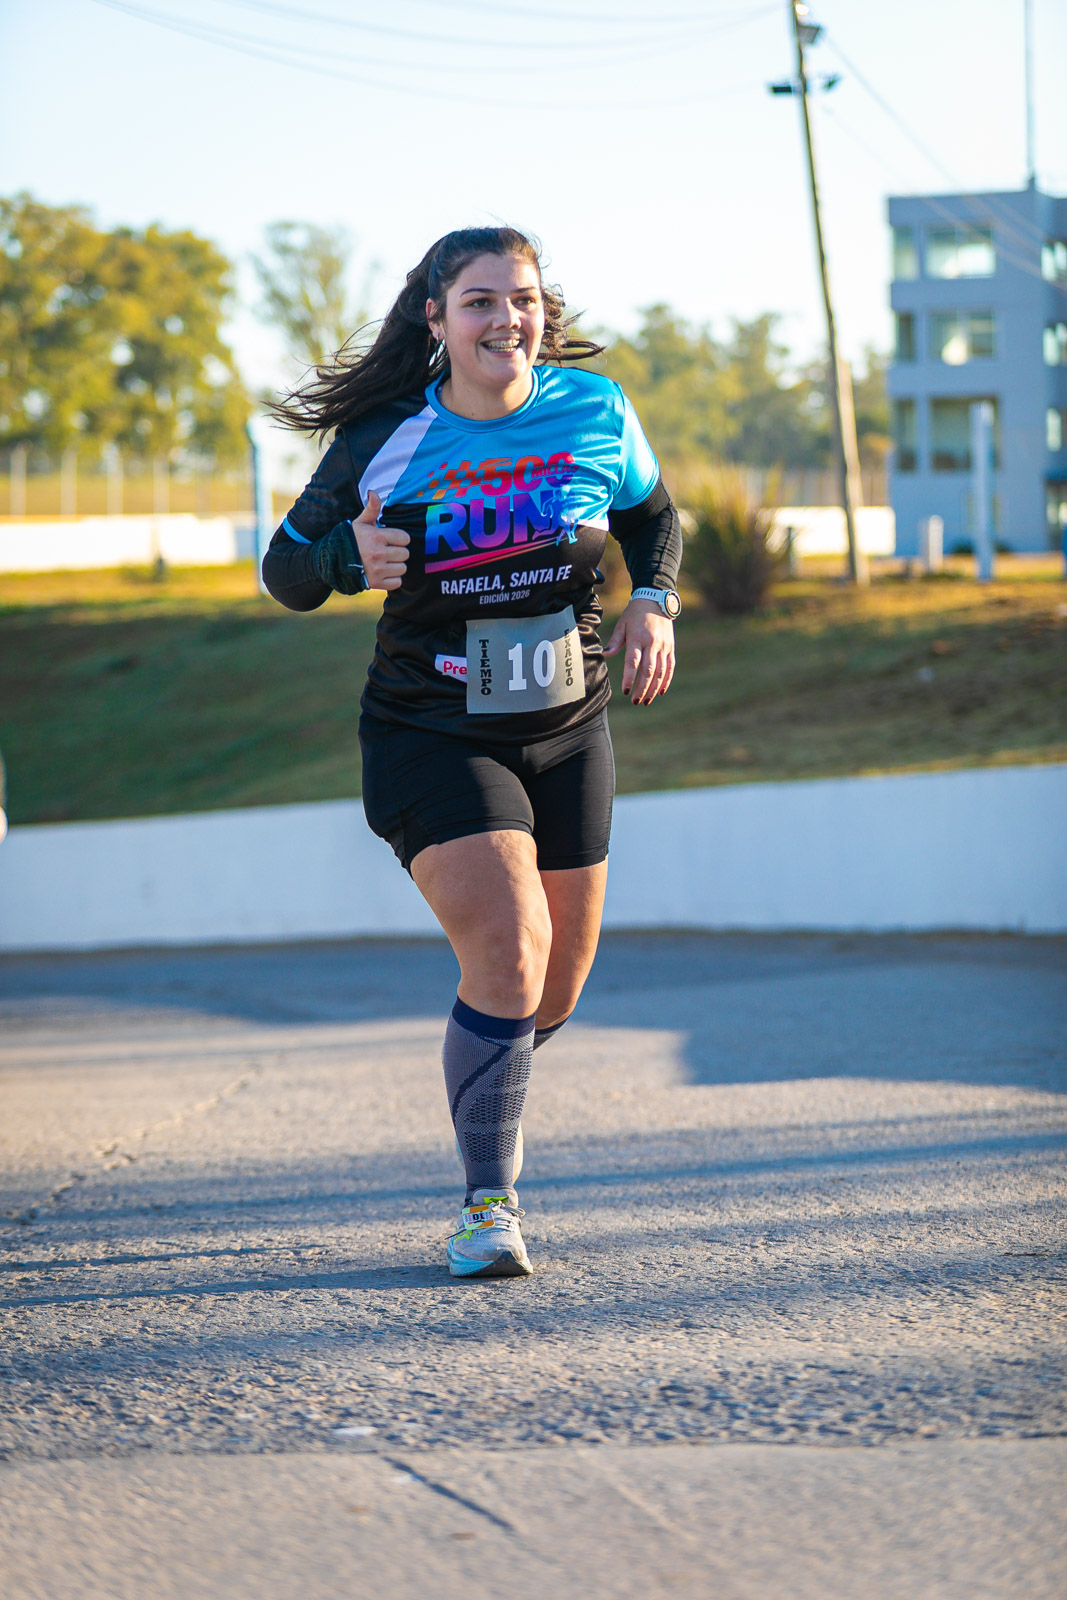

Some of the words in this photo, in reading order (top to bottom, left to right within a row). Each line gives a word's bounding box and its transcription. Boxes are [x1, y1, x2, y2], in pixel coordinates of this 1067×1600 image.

[531, 464, 579, 479] MILLAS
[424, 489, 563, 555] RUN
[441, 574, 505, 595] RAFAELA,
[509, 567, 554, 588] SANTA
[556, 564, 573, 582] FE
[479, 591, 510, 605] EDICIÓN
[511, 589, 530, 601] 2026
[478, 639, 492, 696] TIEMPO
[508, 639, 556, 691] 10
[563, 628, 574, 687] EXACTO
